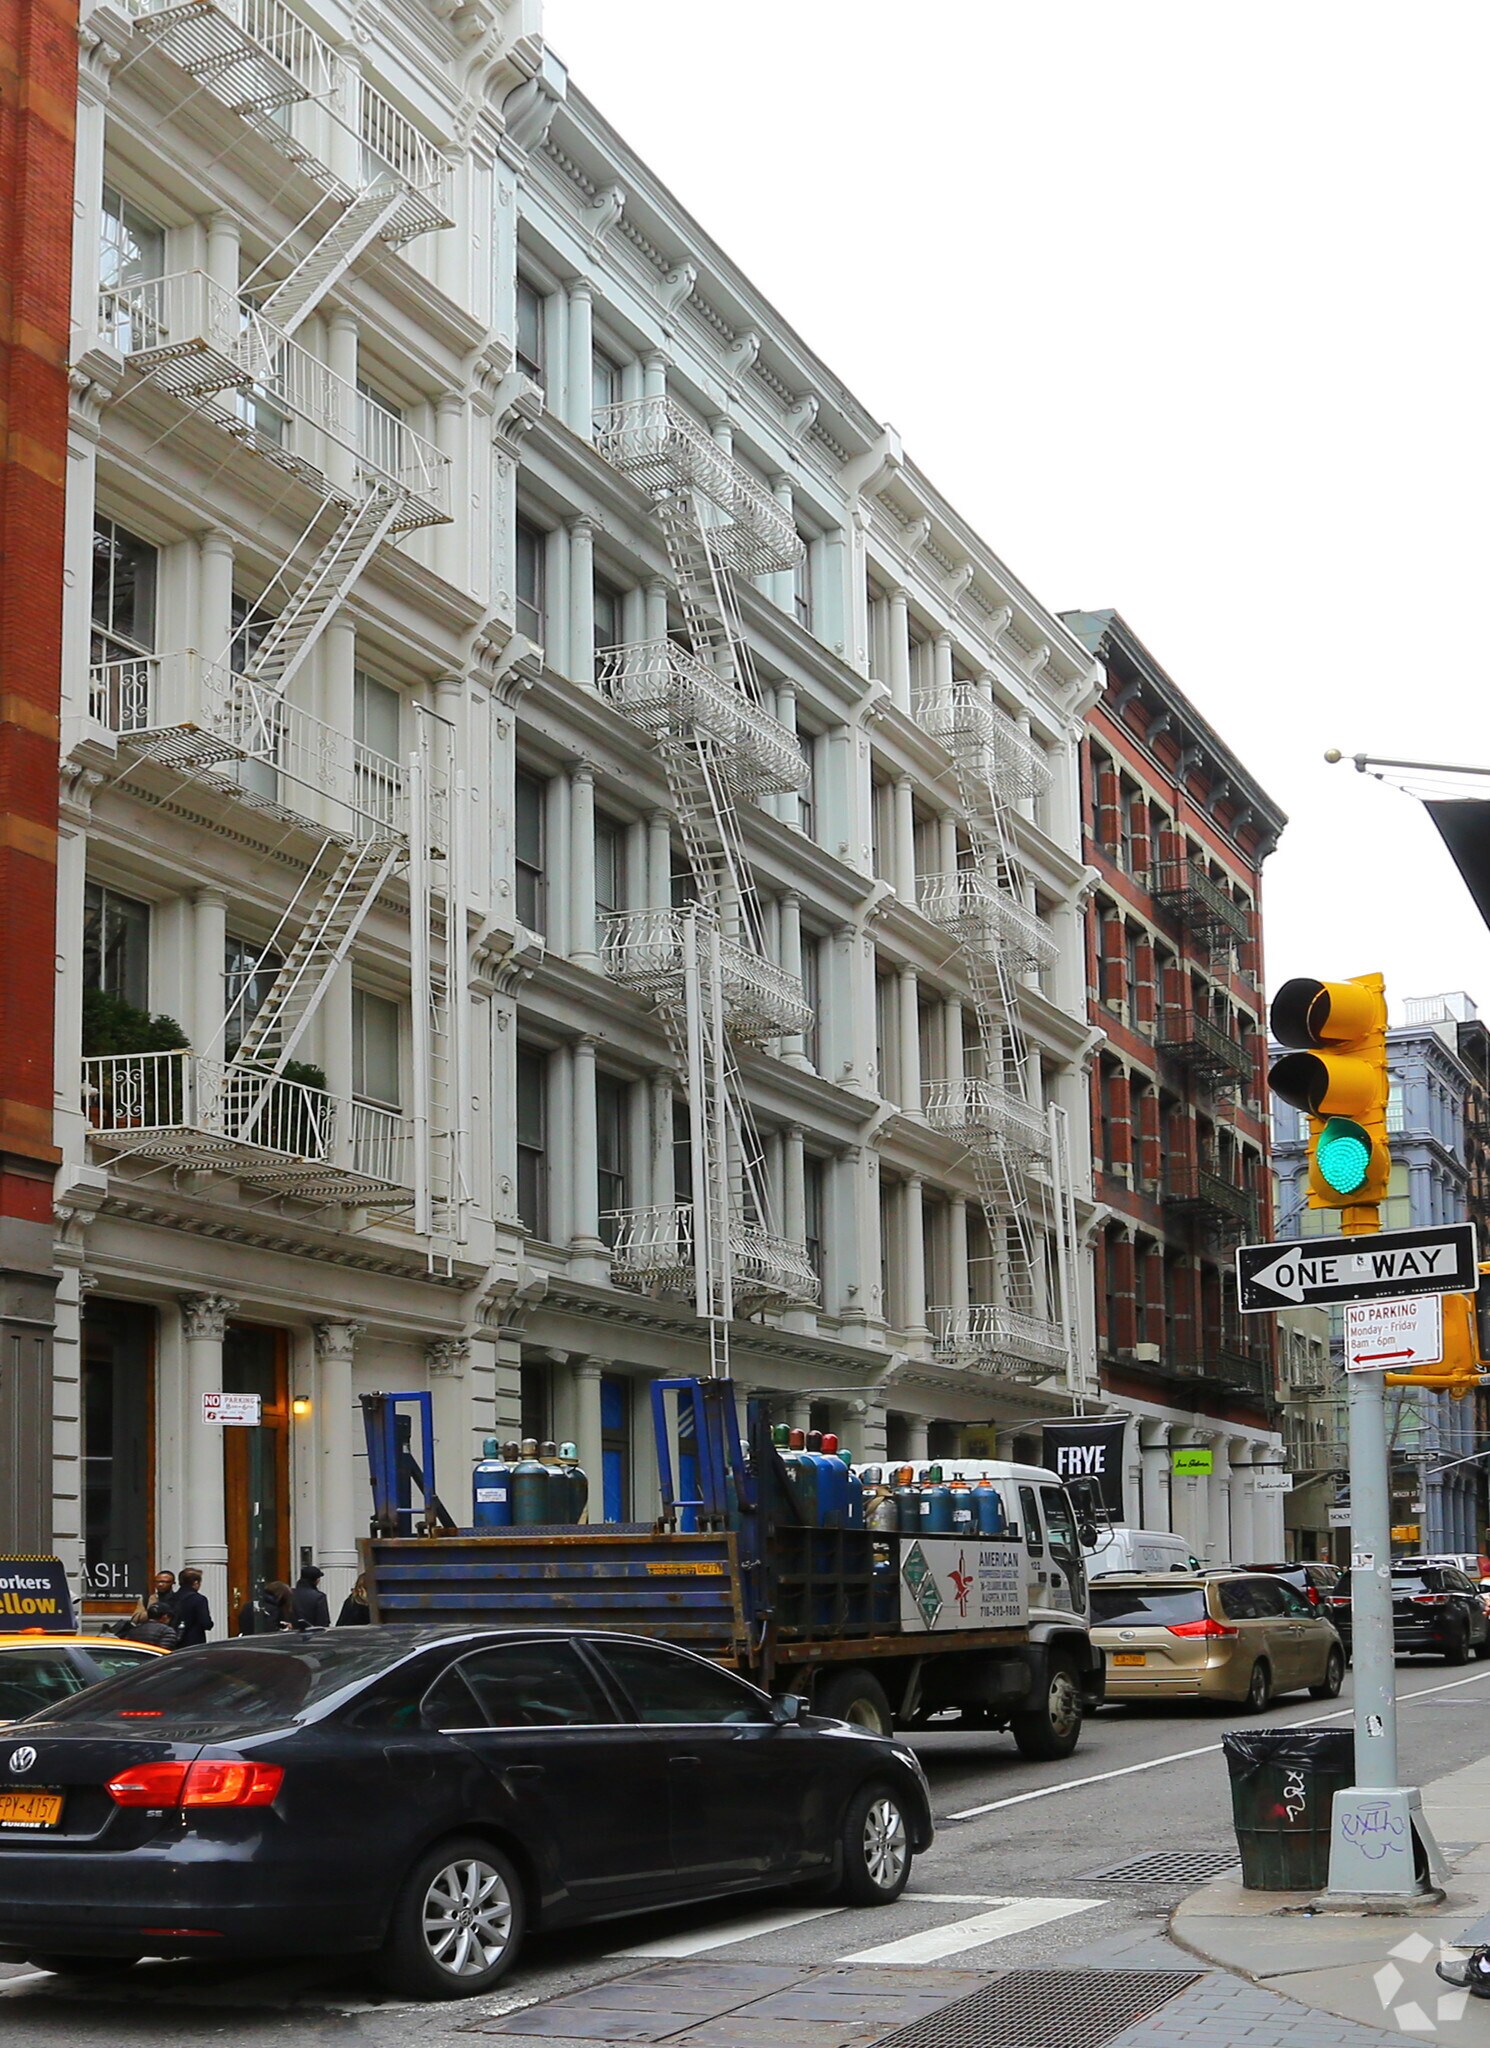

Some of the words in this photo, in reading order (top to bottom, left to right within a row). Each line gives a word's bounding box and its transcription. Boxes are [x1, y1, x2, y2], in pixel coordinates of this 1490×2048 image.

[1275, 1259, 1339, 1288] ONE
[1372, 1248, 1442, 1279] WAY
[1411, 1284, 1466, 1294] TRANSPORTATION
[1350, 1310, 1365, 1323] NO
[1368, 1303, 1417, 1321] PARKING
[1350, 1325, 1383, 1337] Monday
[1390, 1320, 1417, 1332] Friday
[1350, 1339, 1369, 1349] 8am
[1376, 1335, 1396, 1347] 6pm
[204, 1395, 220, 1407] NO
[1057, 1445, 1107, 1475] FRYE
[979, 1552, 1019, 1567] AMERICAN
[80, 1562, 128, 1588] ASH
